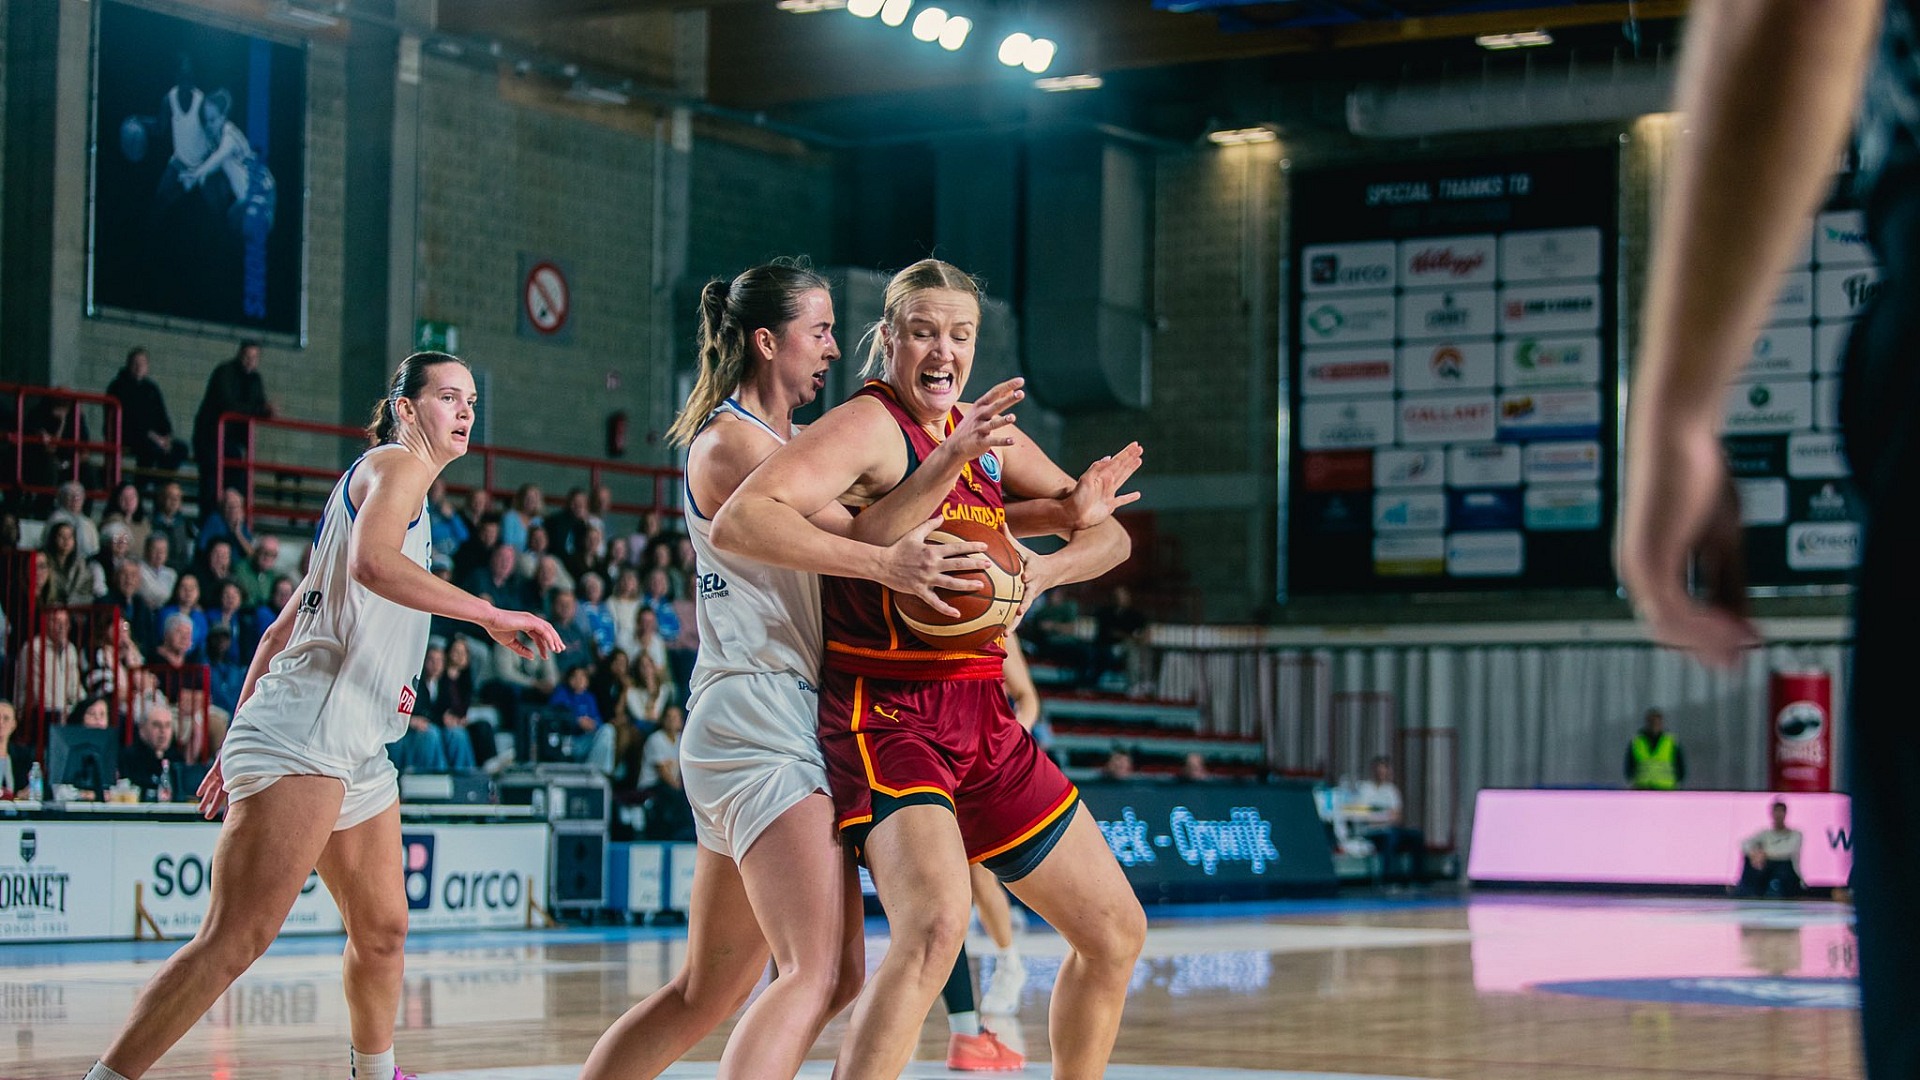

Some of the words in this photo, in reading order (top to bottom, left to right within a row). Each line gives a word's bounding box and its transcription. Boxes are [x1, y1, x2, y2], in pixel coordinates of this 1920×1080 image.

[1367, 181, 1433, 206] SPECIAL
[1438, 176, 1502, 200] THANKS
[1508, 173, 1531, 194] TO
[443, 870, 521, 910] arco
